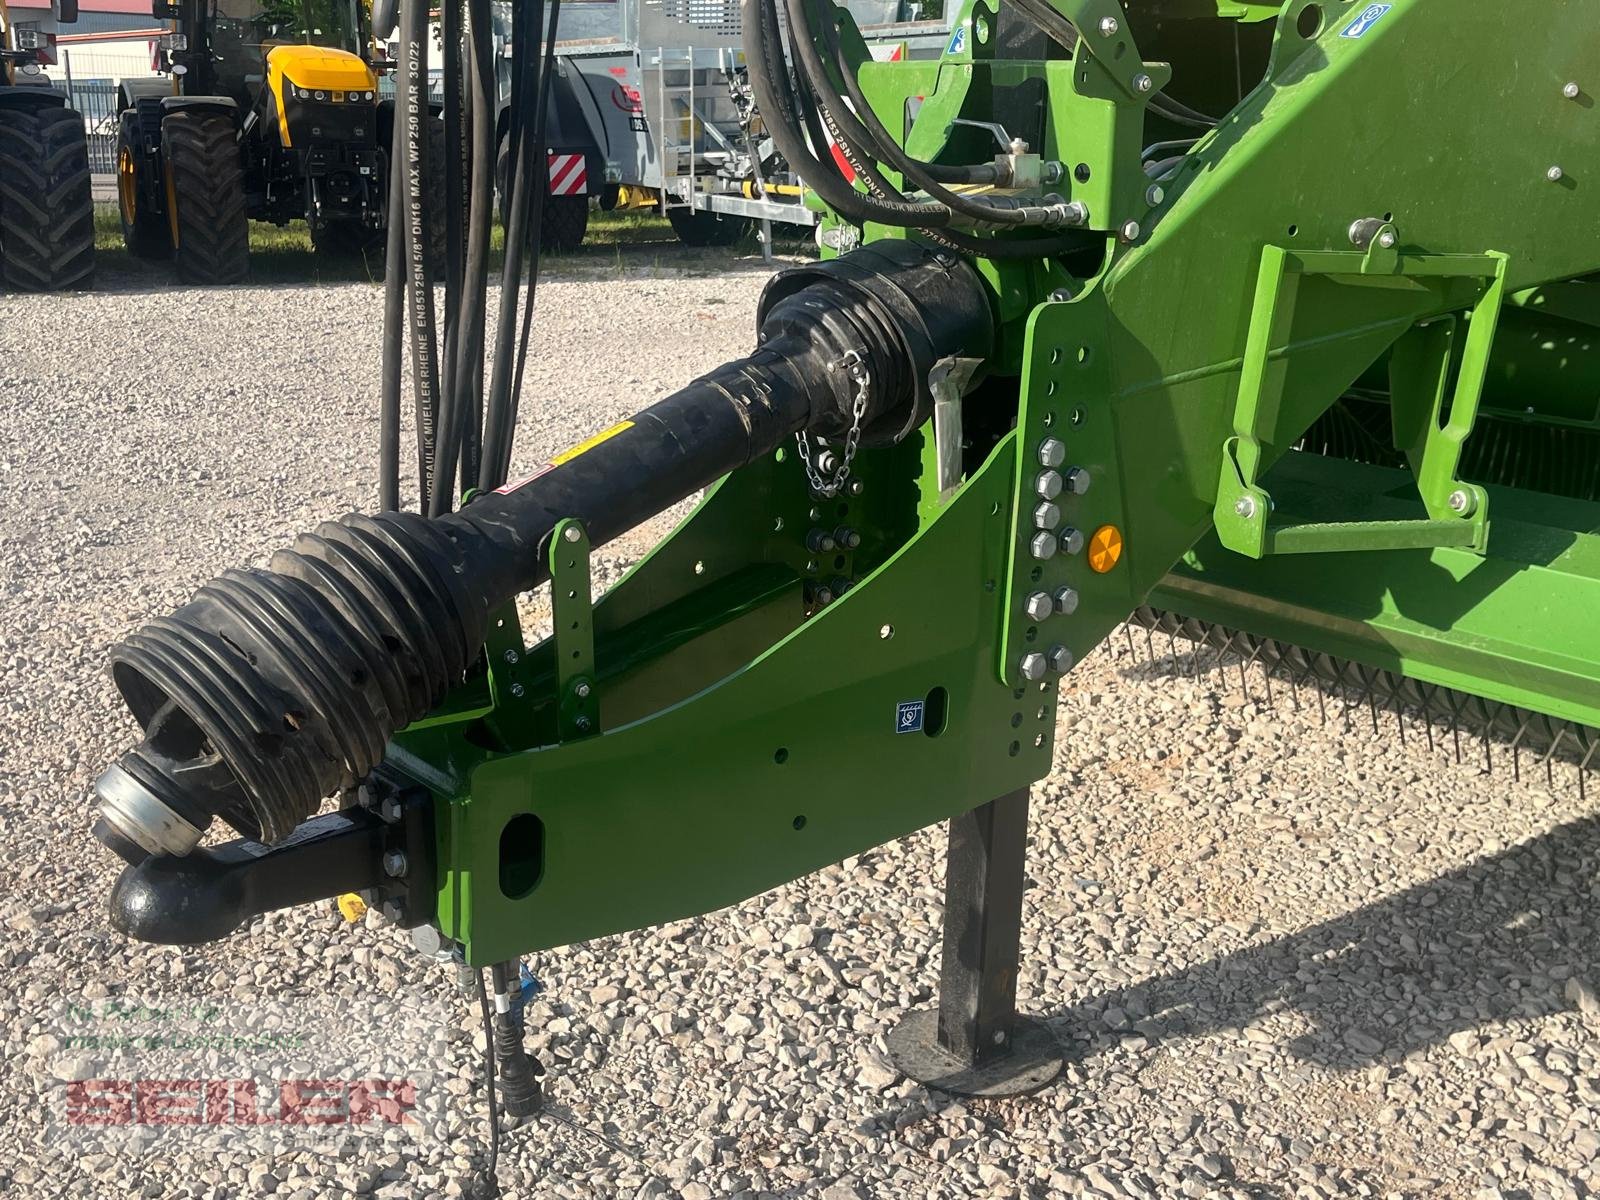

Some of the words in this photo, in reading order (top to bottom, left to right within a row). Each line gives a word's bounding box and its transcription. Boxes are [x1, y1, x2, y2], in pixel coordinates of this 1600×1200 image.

[408, 86, 419, 113] BAR
[408, 116, 419, 139] 250
[409, 141, 420, 162] WP
[818, 102, 840, 136] EN853
[836, 137, 852, 158] 2SN
[863, 175, 886, 199] DN12
[409, 165, 420, 197] MAX.
[853, 190, 906, 212] HYDRAULIK
[906, 202, 946, 214] MUELLER
[411, 202, 422, 235] DN16
[412, 238, 423, 261] 5/8"
[938, 238, 960, 251] BAR
[413, 264, 425, 288] 2SN
[415, 290, 427, 328] EN853
[418, 334, 430, 378] RHEINE
[421, 381, 433, 435] MUELLER
